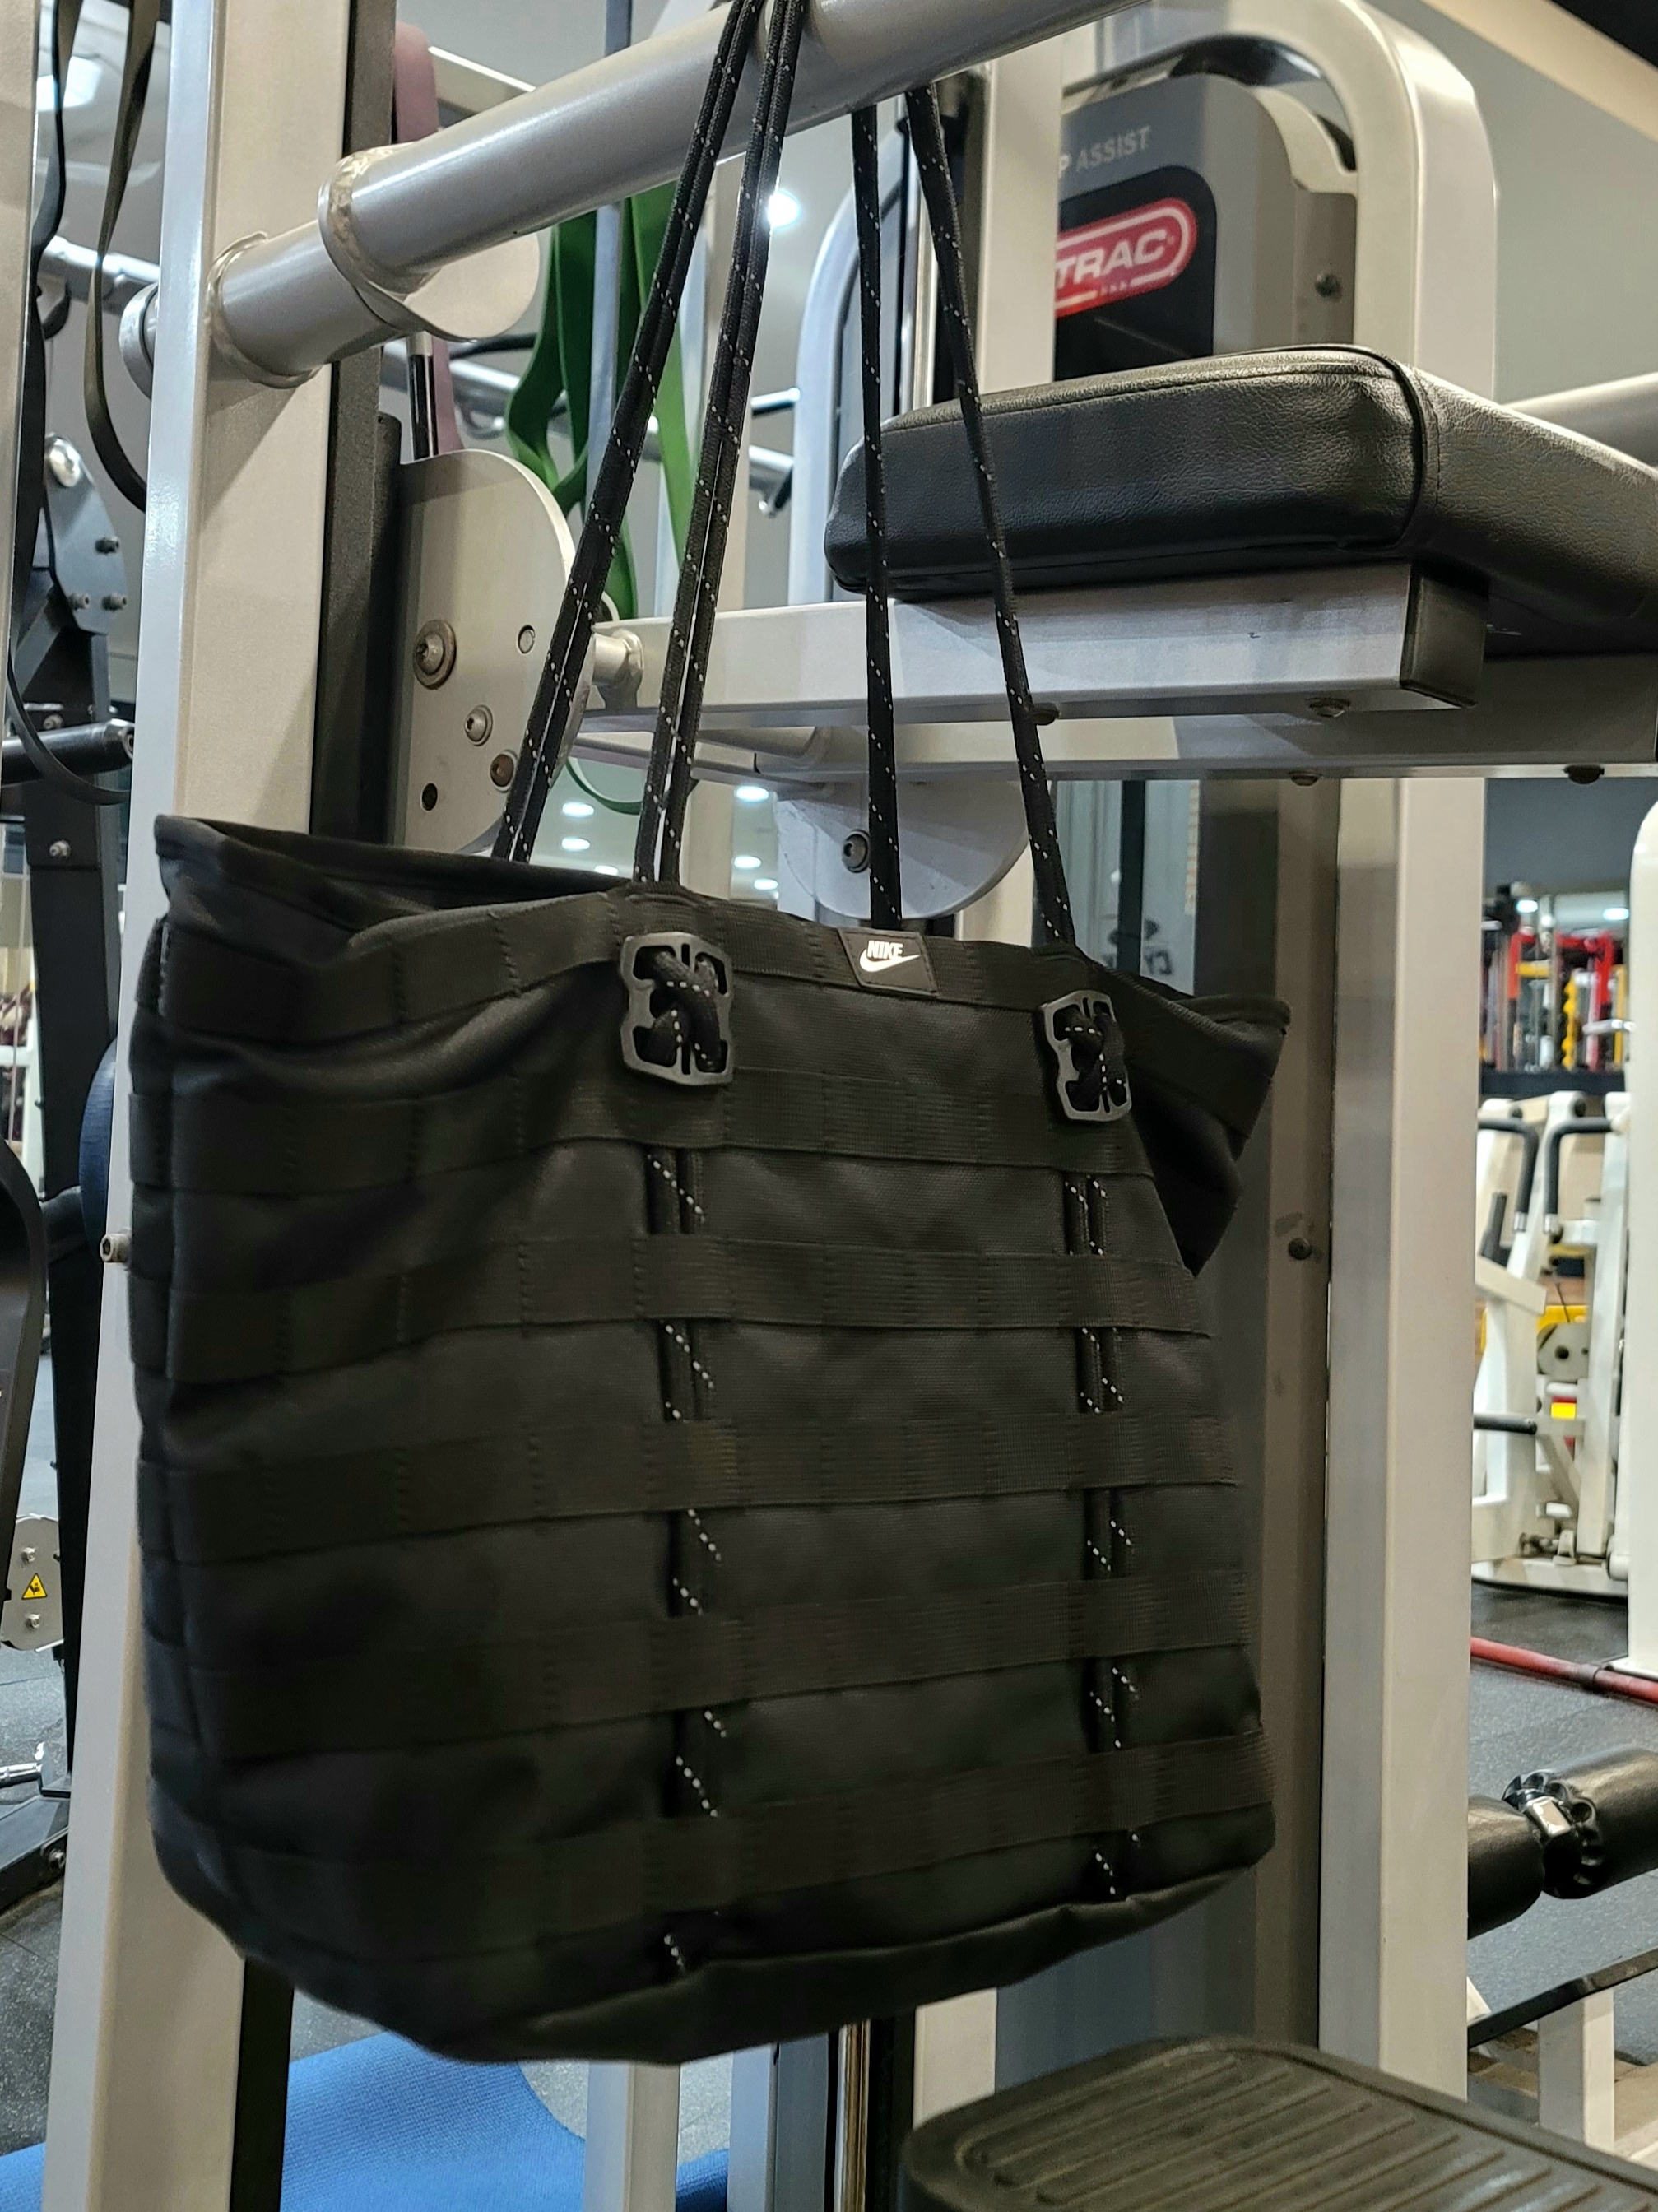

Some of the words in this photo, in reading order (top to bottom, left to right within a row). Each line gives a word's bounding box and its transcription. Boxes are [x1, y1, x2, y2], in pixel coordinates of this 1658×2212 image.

[1075, 125, 1150, 171] ASSIST
[1056, 229, 1168, 289] TRAC
[866, 940, 903, 960] NIKE
